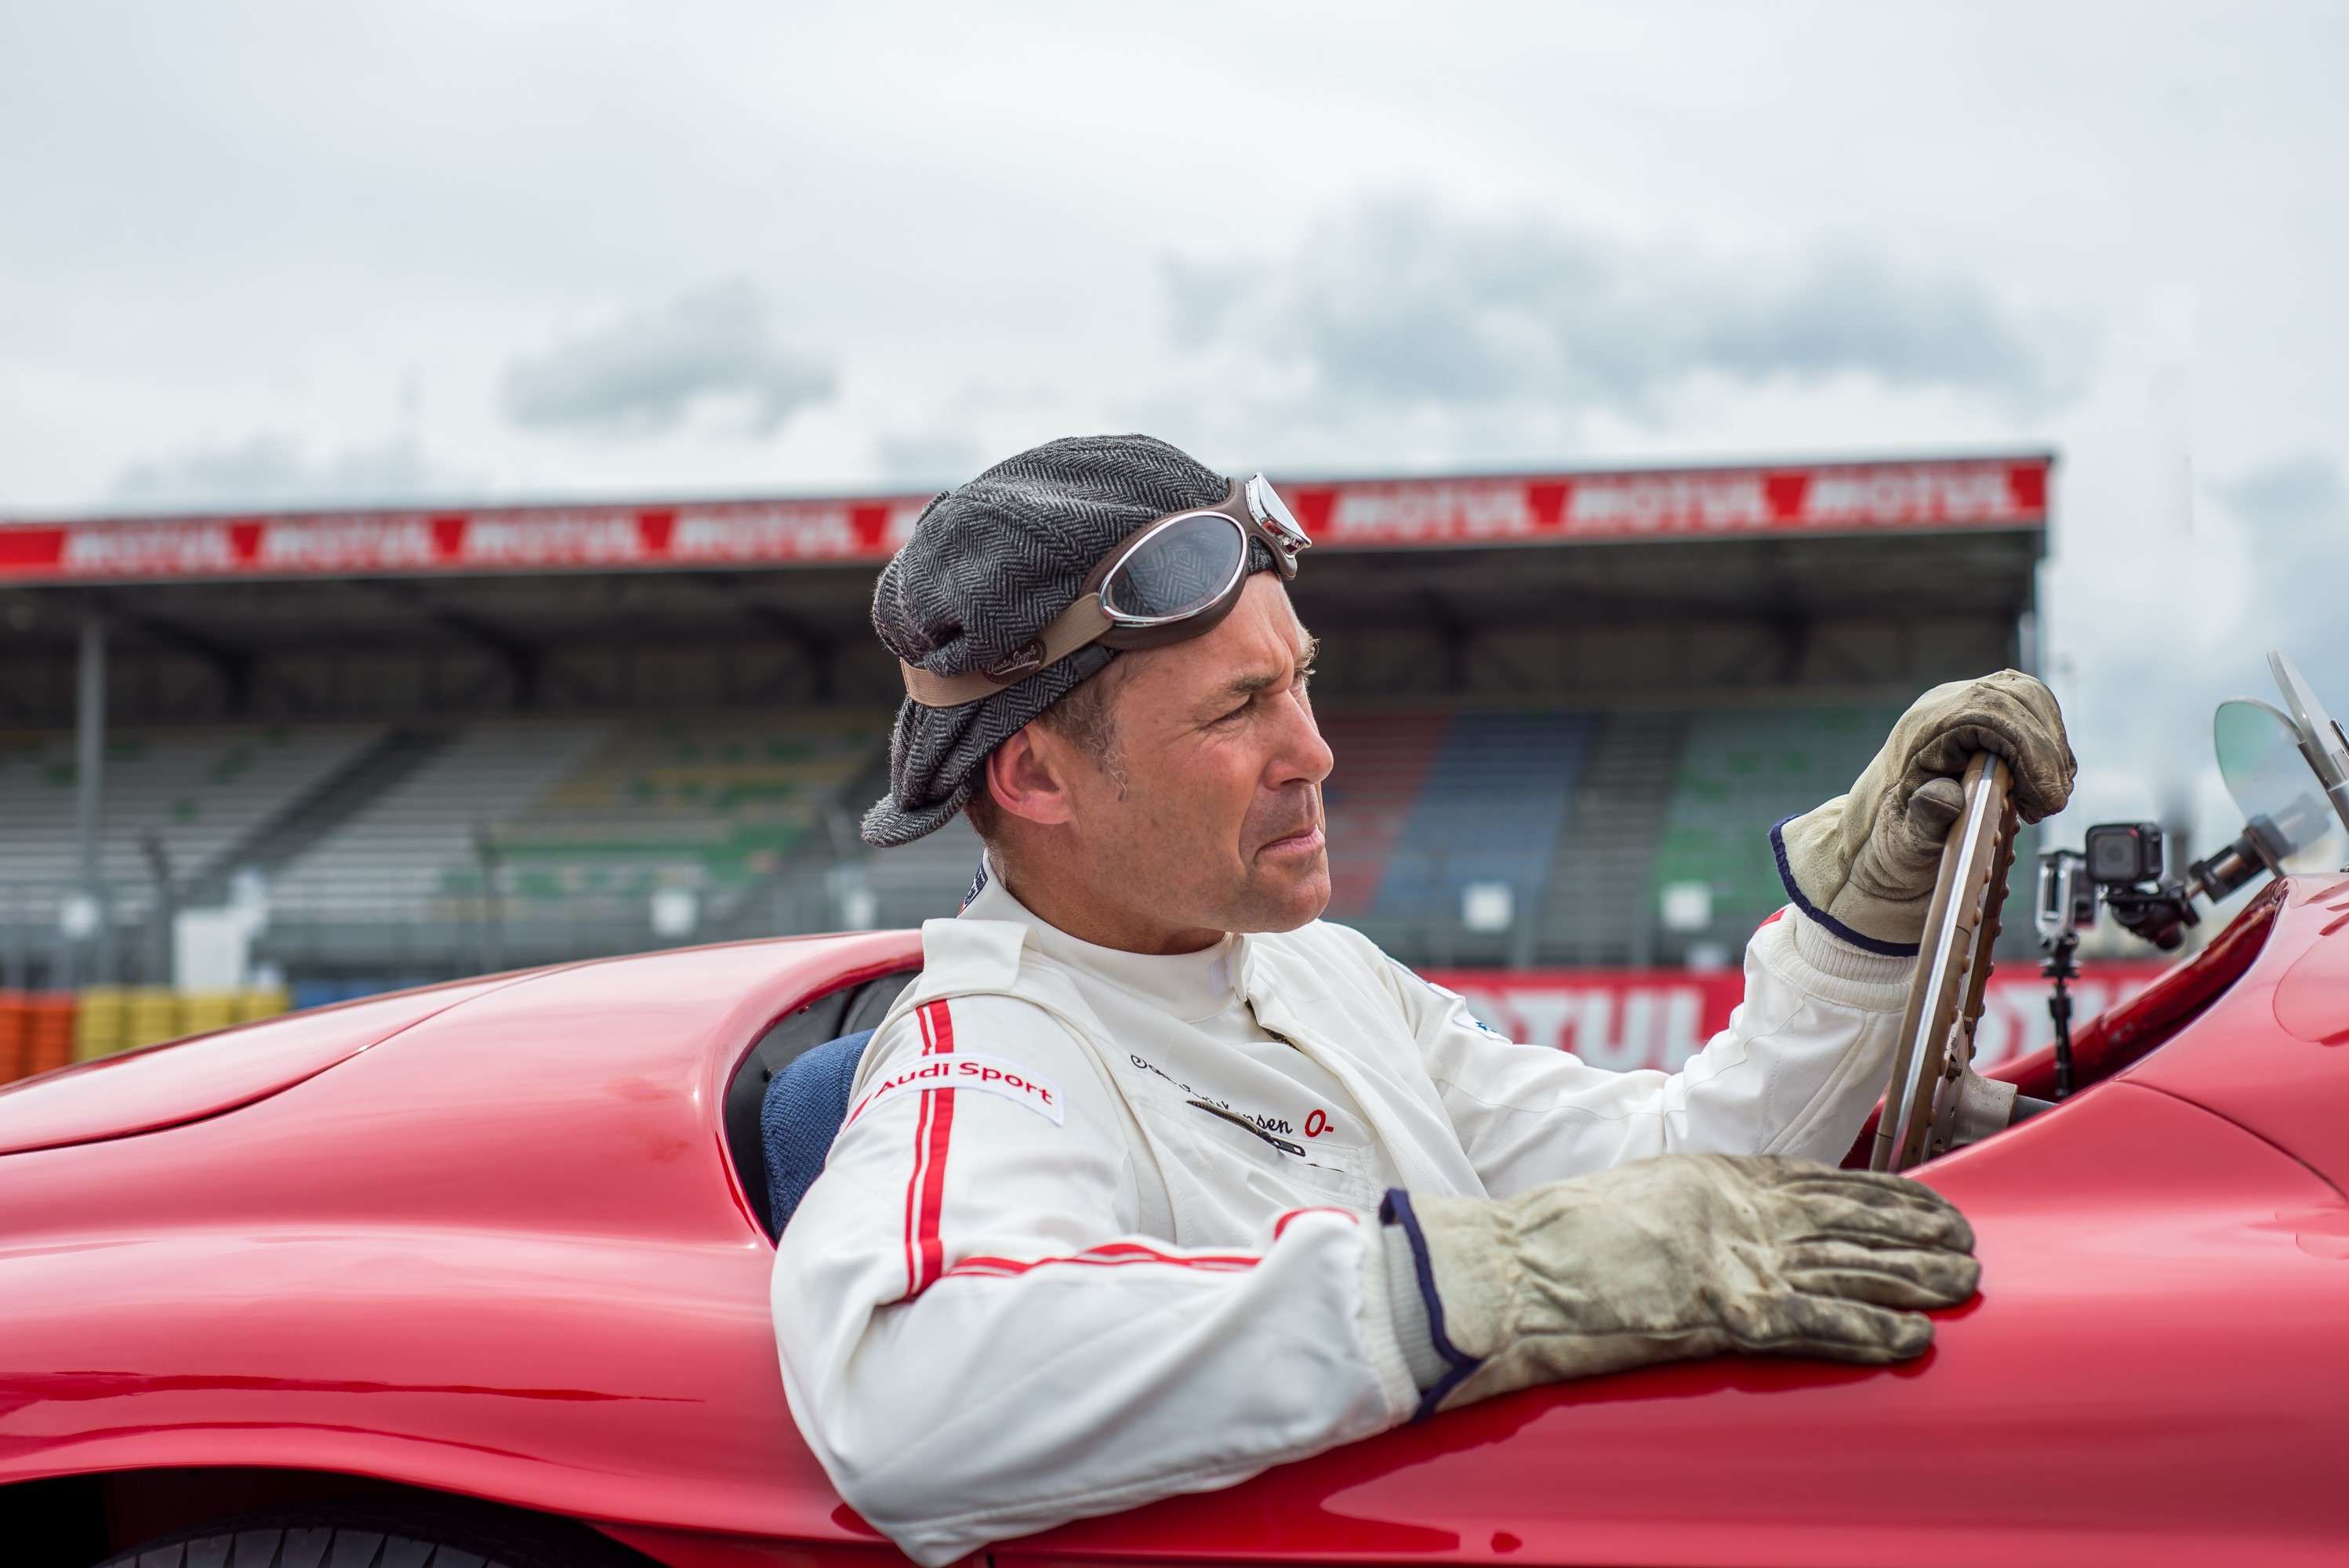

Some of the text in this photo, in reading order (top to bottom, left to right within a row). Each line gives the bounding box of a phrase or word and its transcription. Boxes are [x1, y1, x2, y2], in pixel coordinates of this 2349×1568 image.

[1331, 489, 1533, 536] MOTUL
[1567, 479, 1772, 530] MOTUL
[1803, 466, 2013, 519] MOTUL
[874, 1062, 1052, 1105] Audi Sport
